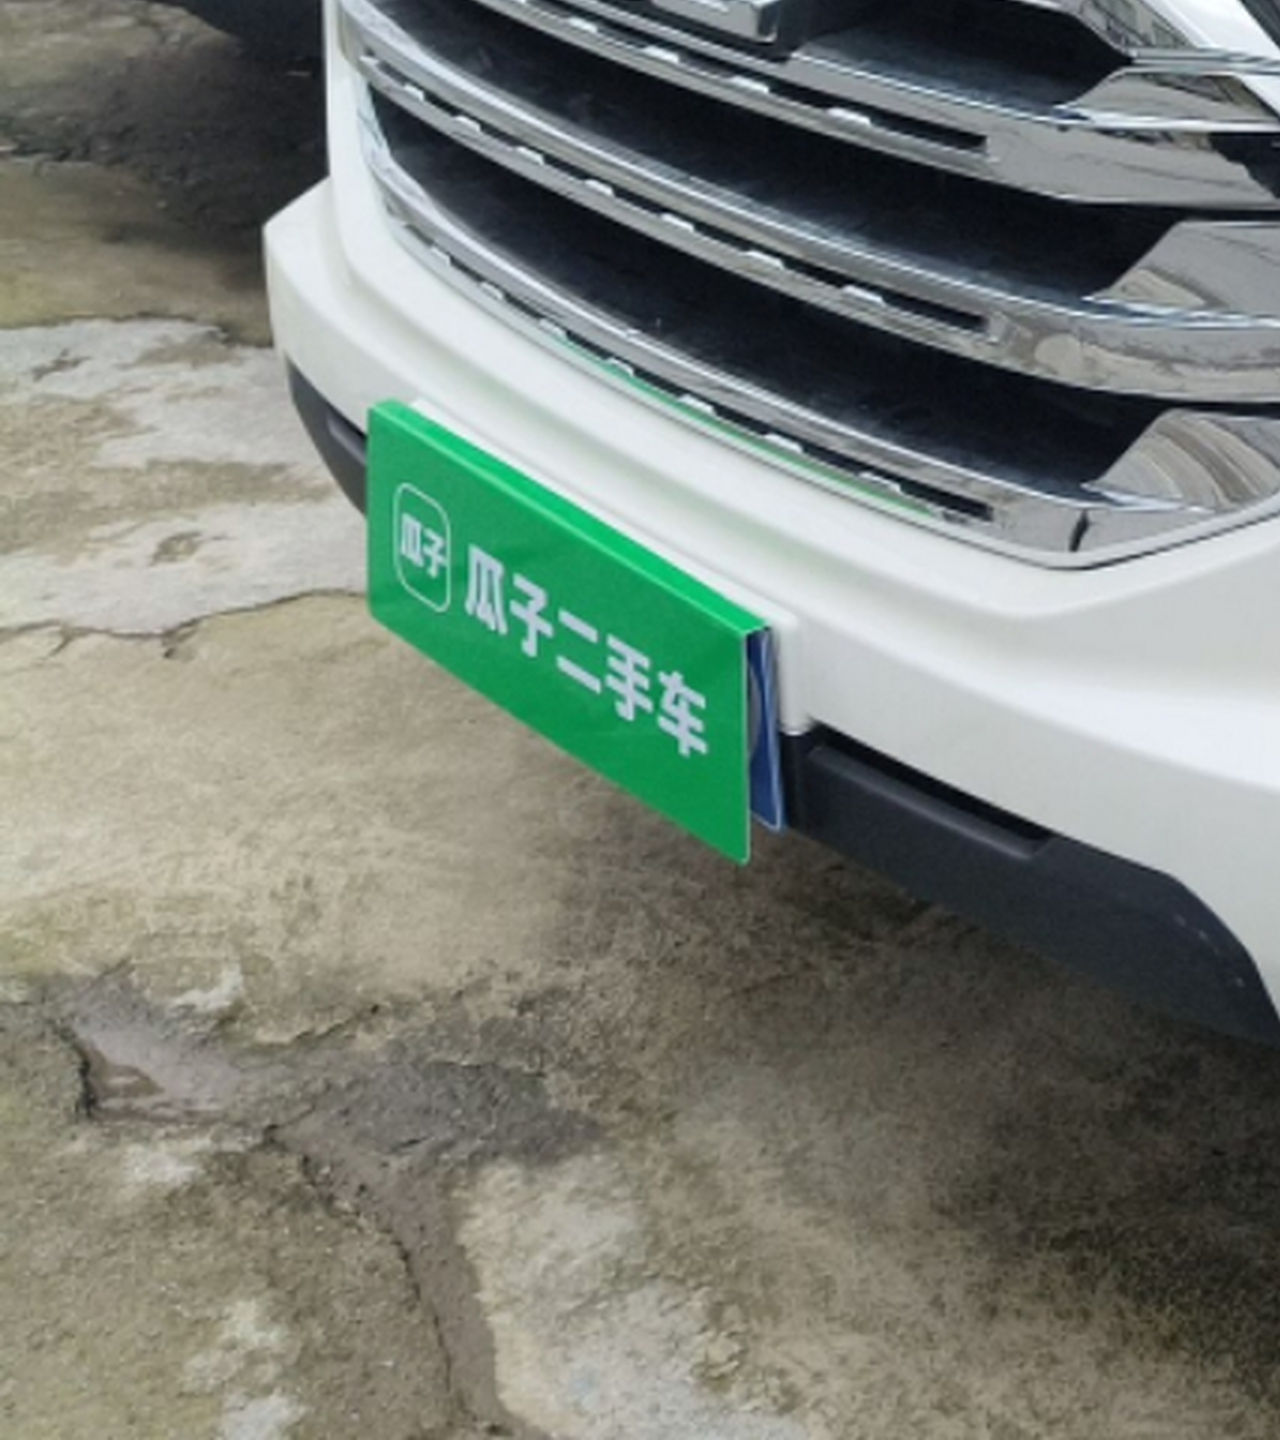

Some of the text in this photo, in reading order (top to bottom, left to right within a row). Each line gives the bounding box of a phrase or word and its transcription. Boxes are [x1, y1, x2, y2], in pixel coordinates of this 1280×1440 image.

[399, 511, 448, 580] 瓜子
[465, 544, 709, 758] 瓜子二手车
